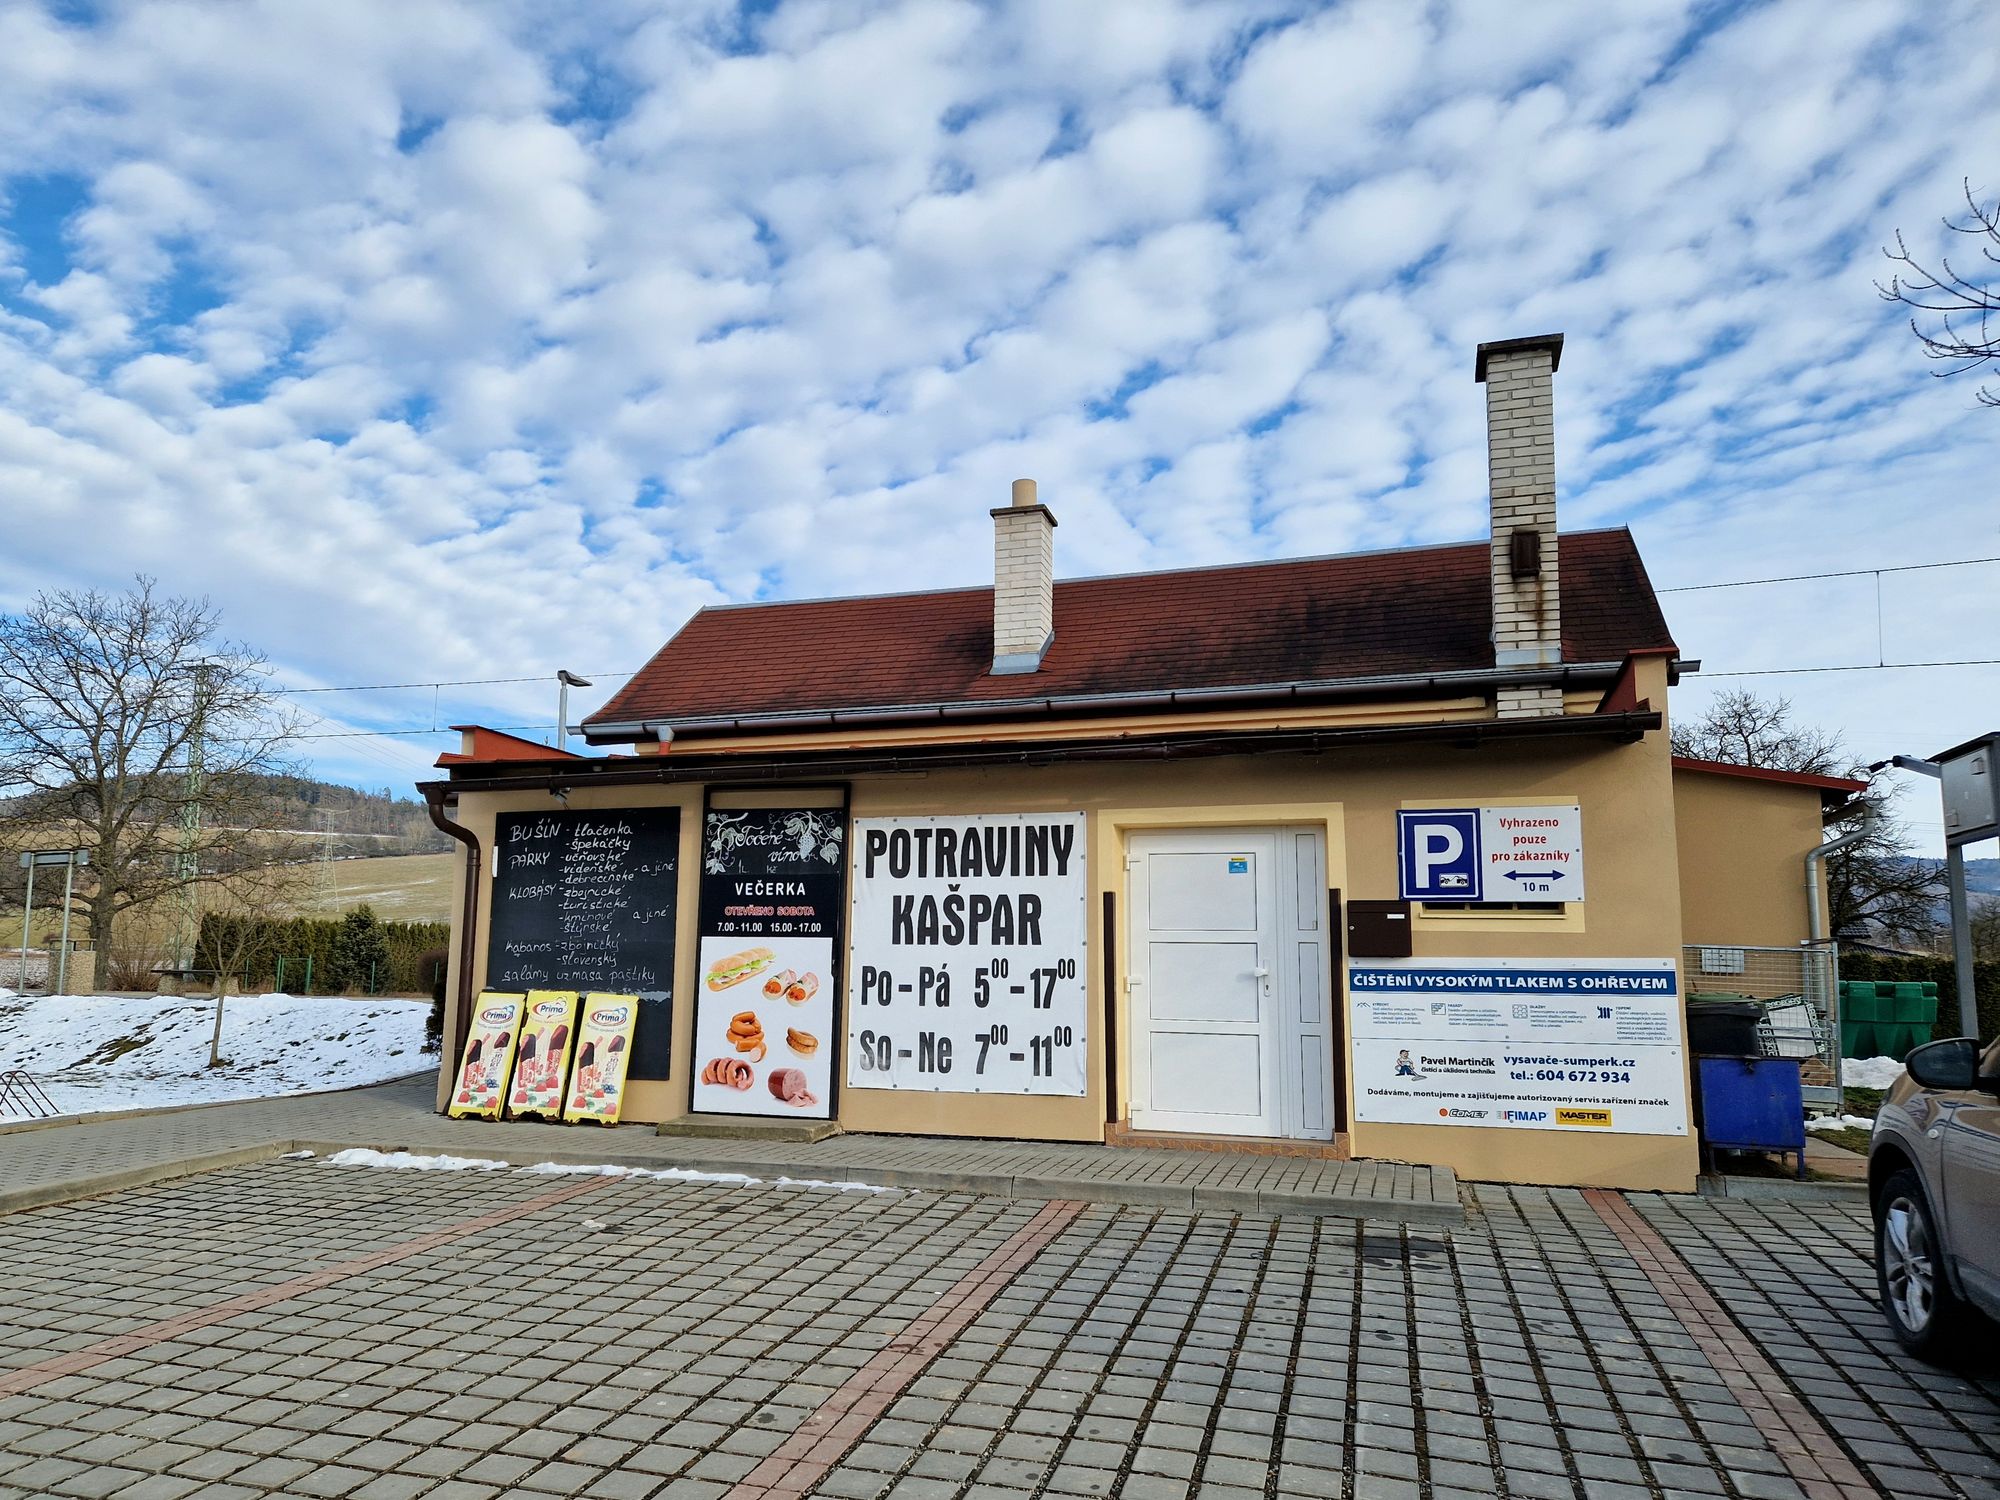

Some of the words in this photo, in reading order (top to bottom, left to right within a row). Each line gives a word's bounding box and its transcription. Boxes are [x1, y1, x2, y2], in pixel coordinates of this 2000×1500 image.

[1499, 818, 1559, 830] Vyhrazeno
[1513, 835, 1547, 846] pouze
[768, 846, 800, 862] víno
[865, 824, 1074, 879] POTRAVINY
[1414, 824, 1464, 889] P
[1491, 853, 1511, 862] pro
[1513, 850, 1570, 863] zákazníky
[735, 880, 806, 896] VEČERKA
[1522, 882, 1536, 891] 10
[724, 904, 775, 916] OTEVŘENO
[776, 906, 815, 916] SOBOTA
[891, 883, 1042, 946] KAŠPAR
[717, 922, 735, 931] 7.00
[740, 923, 763, 932] 11.00
[770, 922, 793, 932] 15.00
[798, 922, 822, 932] 17.00
[1353, 973, 1412, 987] ČIŠTĚNÍ
[1414, 975, 1493, 987] VYSOKÝM
[1495, 976, 1564, 988] TLAKEM
[1567, 977, 1578, 989] S
[1580, 975, 1668, 989] OHŘEVEM
[540, 1005, 563, 1013] Prima
[596, 1013, 620, 1021] Prima
[1421, 1056, 1446, 1065] Pavel
[1448, 1057, 1496, 1067] Martinčík
[1503, 1055, 1636, 1068] vysavače-sumperk.cz
[1510, 1071, 1534, 1081] tel.:
[1536, 1070, 1565, 1081] 604
[1568, 1071, 1598, 1082] 672
[1601, 1072, 1630, 1083] 934
[1367, 1088, 1411, 1097] Dodáváme,
[1413, 1090, 1460, 1099] montujeme
[1467, 1091, 1515, 1101] zajišťujeme
[1517, 1094, 1572, 1103] autorizovaný
[1574, 1095, 1600, 1104] servis
[1601, 1097, 1637, 1105] zařízení
[1638, 1098, 1669, 1106] značek
[1449, 1109, 1489, 1119] COMET
[1507, 1111, 1547, 1121] FIMAP
[1560, 1112, 1608, 1120] MASTER
